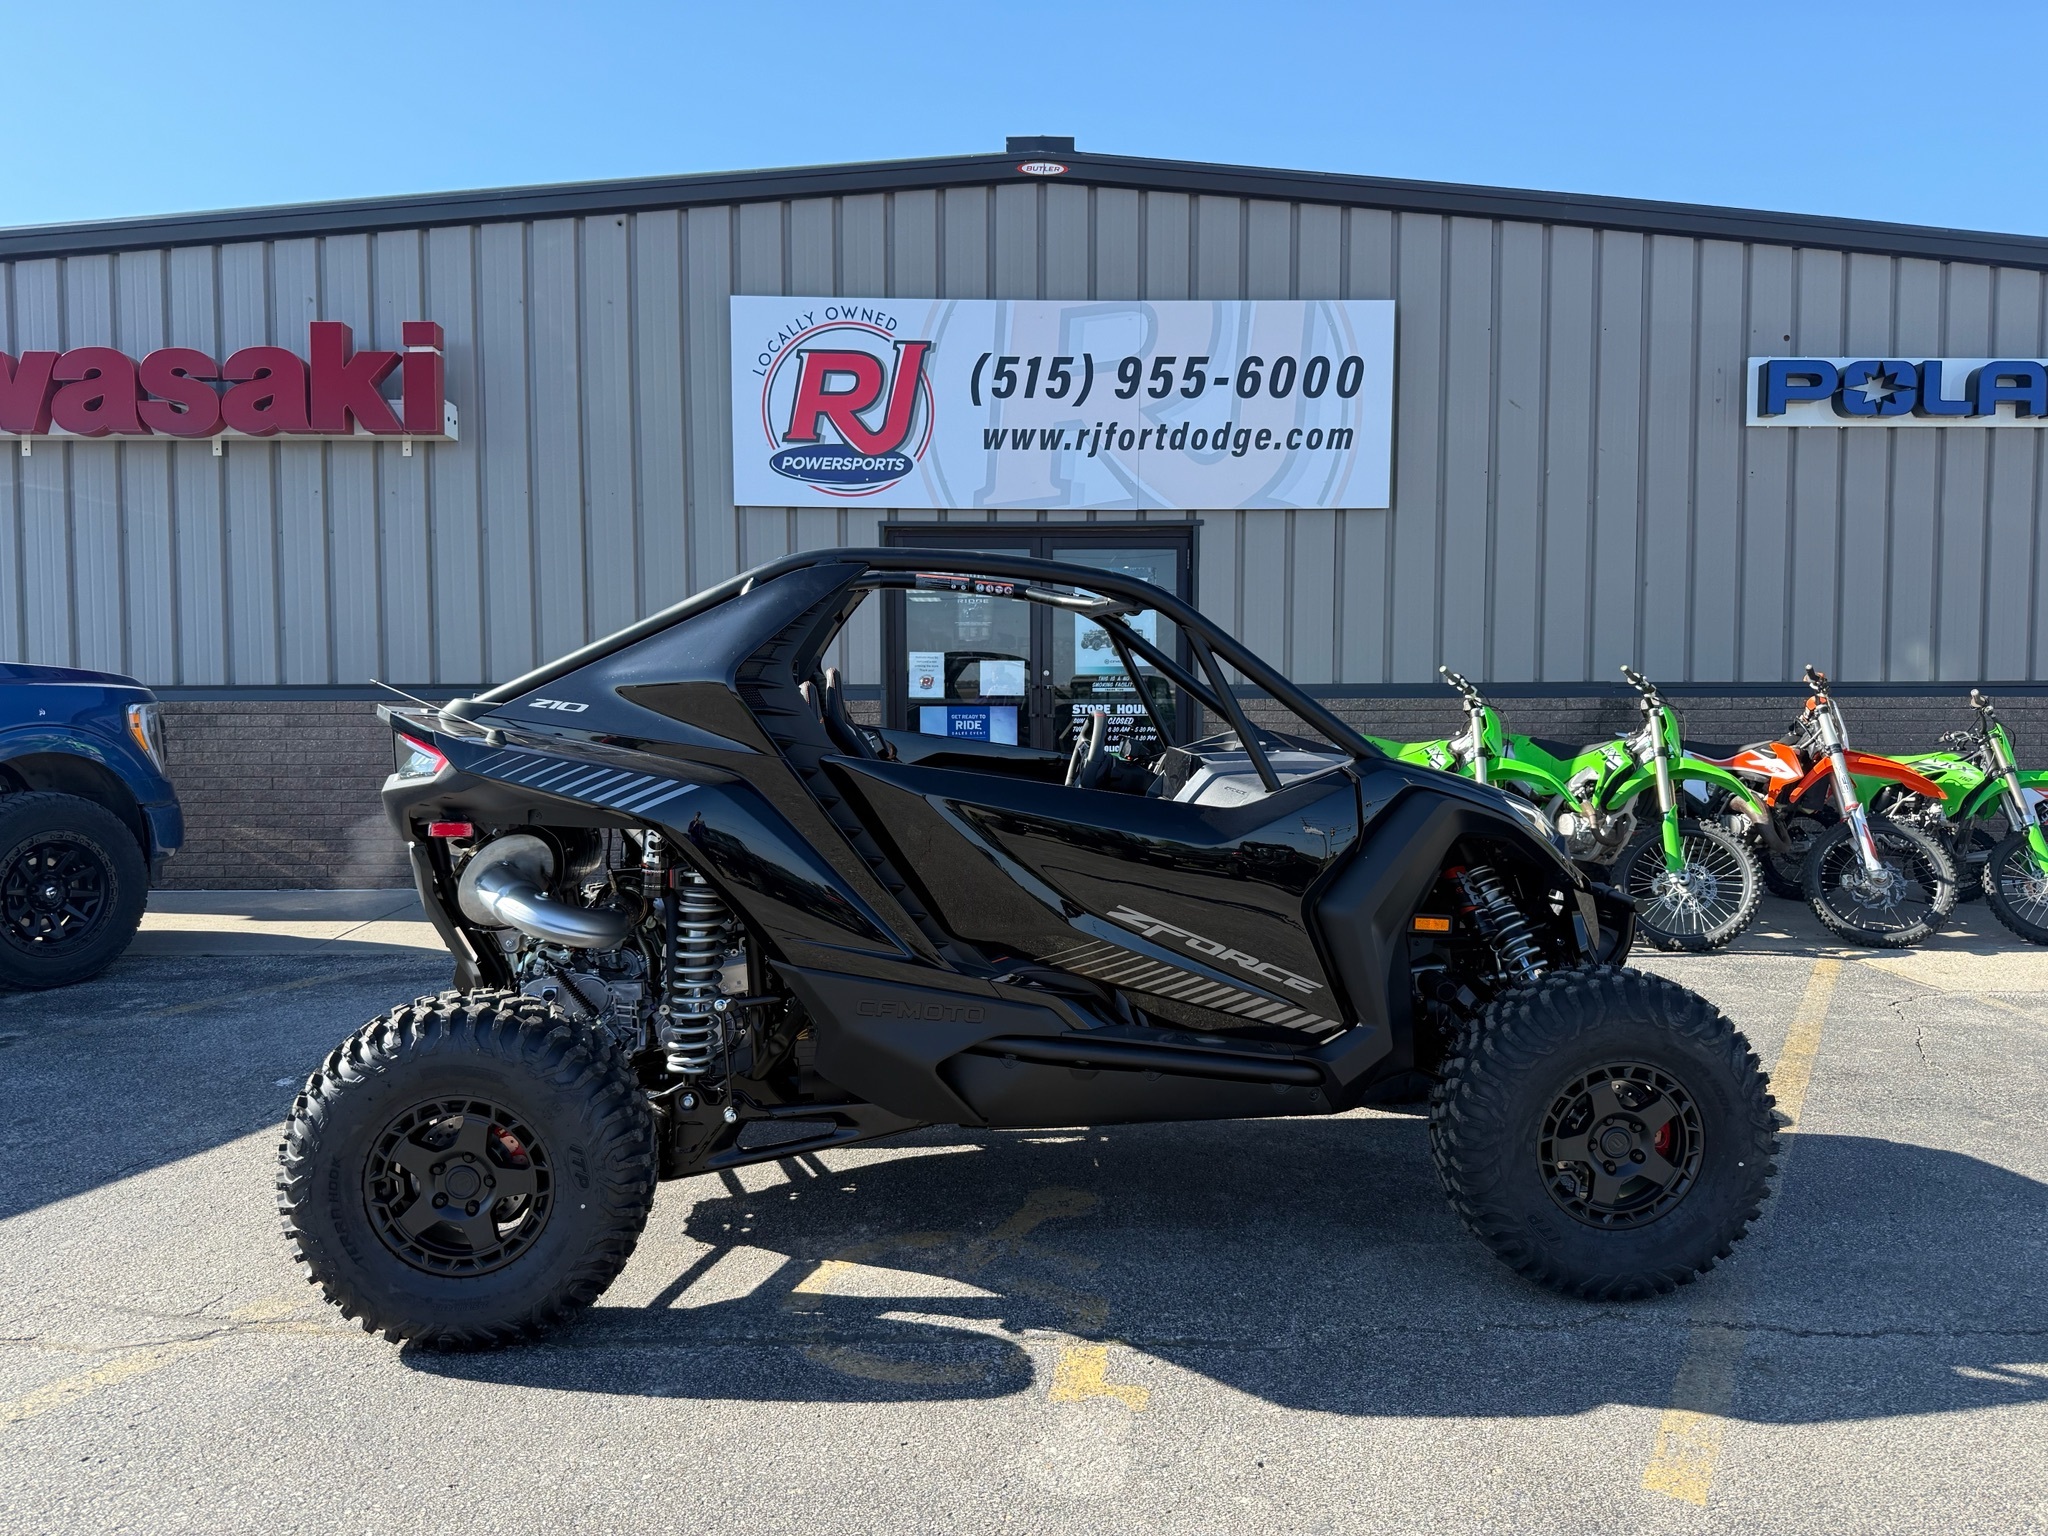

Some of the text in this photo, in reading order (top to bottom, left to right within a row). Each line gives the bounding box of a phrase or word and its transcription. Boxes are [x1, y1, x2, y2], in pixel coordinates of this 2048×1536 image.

[752, 305, 898, 377] LOCALLY OWNED
[969, 353, 1365, 407] (515) 955-6000
[781, 340, 936, 456] RJ
[982, 421, 1354, 458] www.rjfortdodge.com
[781, 456, 905, 472] POWERSPORTS
[528, 698, 590, 713] Z10
[1117, 704, 1148, 714] HOU
[955, 720, 982, 730] RIDE
[1107, 717, 1134, 725] CLOSED
[1106, 904, 1324, 995] ZFORCE
[856, 1000, 986, 1024] CFMOTO
[569, 1143, 591, 1189] ITP
